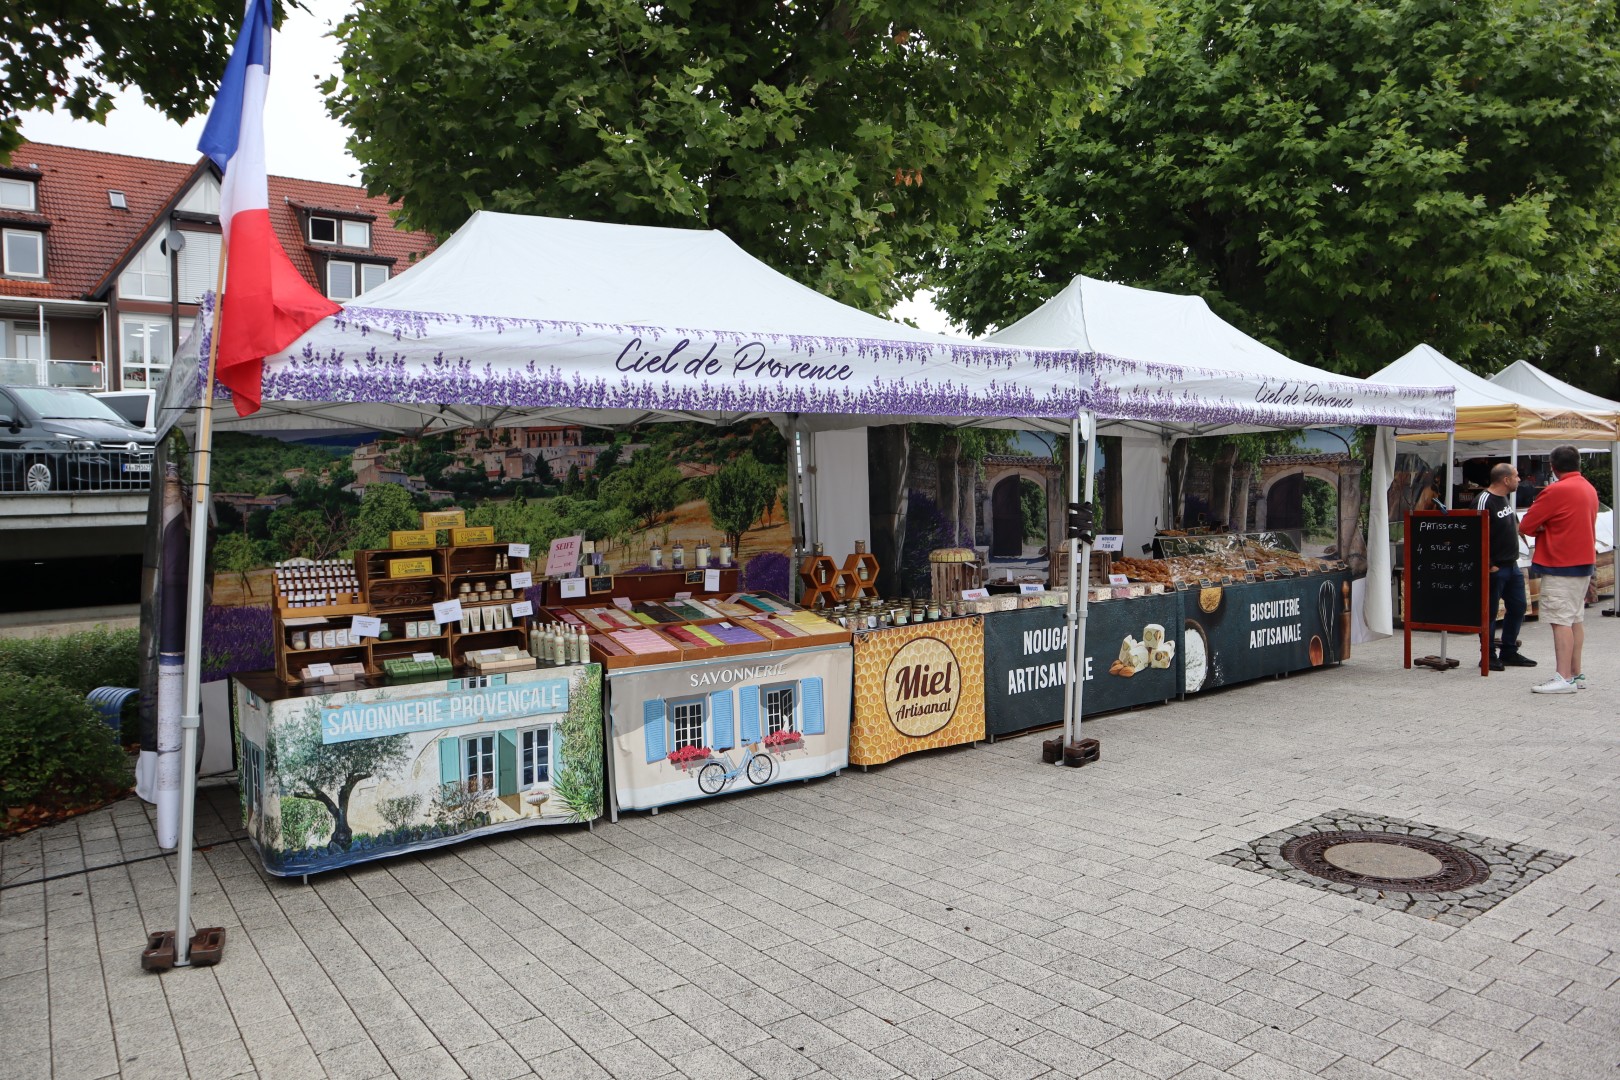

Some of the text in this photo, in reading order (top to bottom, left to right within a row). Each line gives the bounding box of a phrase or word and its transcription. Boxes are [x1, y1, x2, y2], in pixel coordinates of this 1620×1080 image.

[615, 338, 853, 380] Ciel de Provence
[1255, 381, 1354, 408] Ciel de Provence
[555, 542, 575, 551] SEIFE
[1250, 597, 1300, 622] BISCUITERIE
[1249, 623, 1302, 649] ARTISANALE
[690, 663, 788, 687] SAVONNERIE
[895, 661, 952, 702] Miel
[1008, 656, 1094, 695] ARTISANE
[327, 684, 562, 737] SAVONNERIE PROVENÇALE
[895, 698, 952, 722] Artisanal
